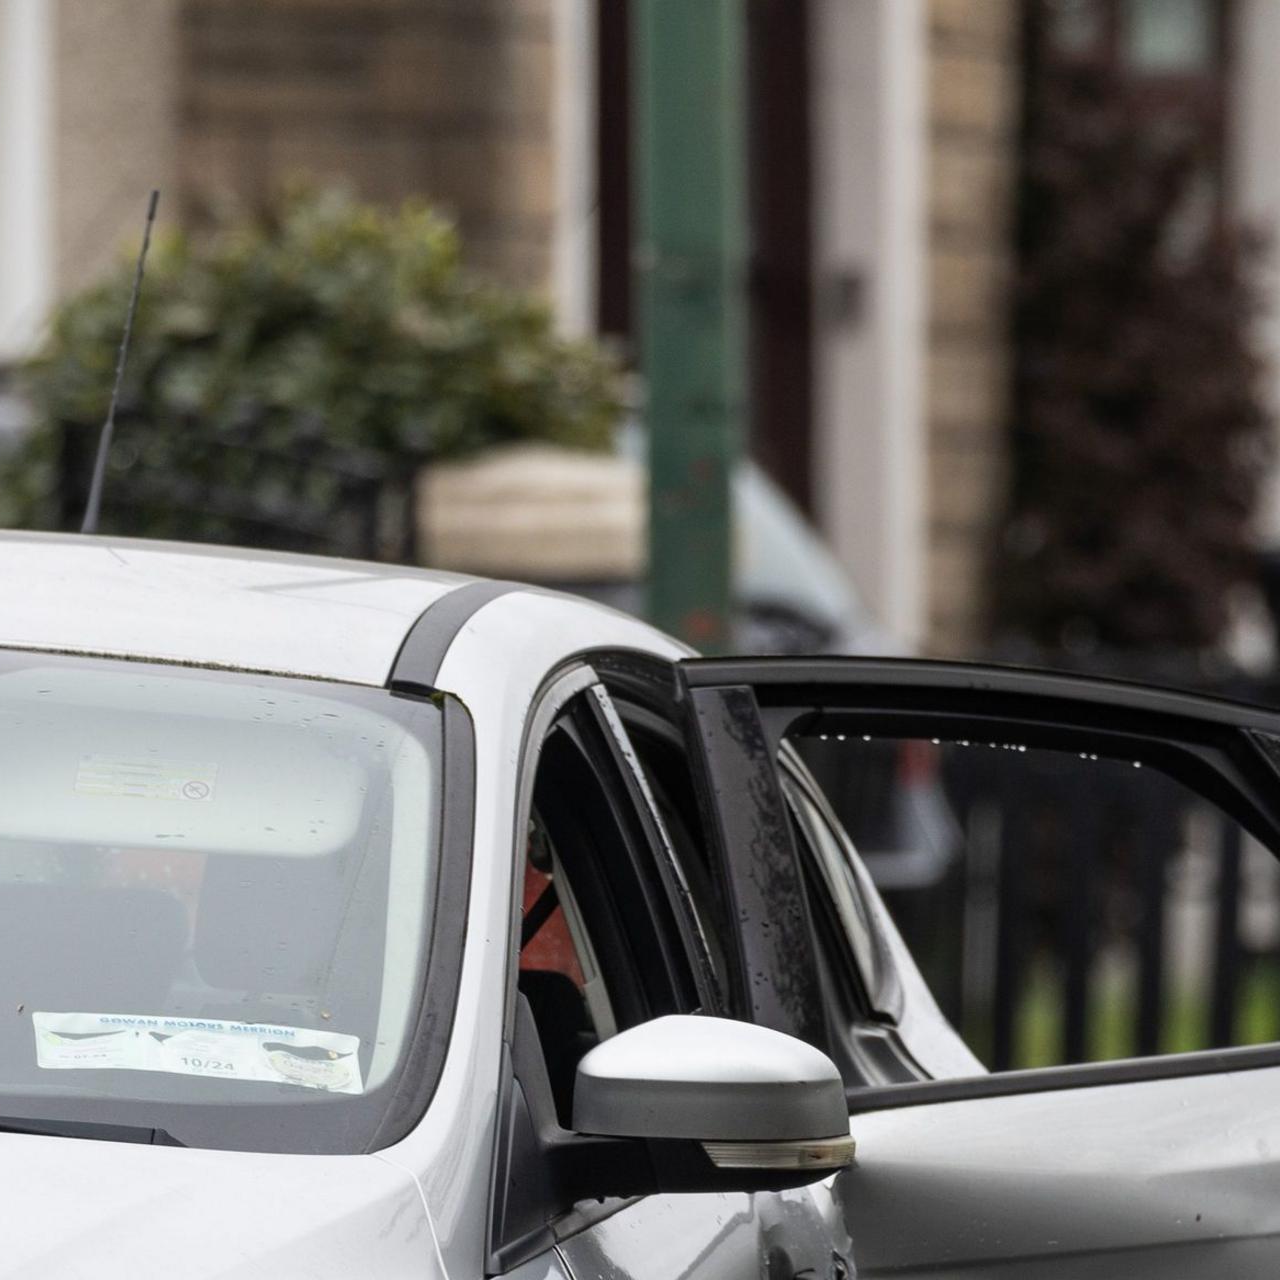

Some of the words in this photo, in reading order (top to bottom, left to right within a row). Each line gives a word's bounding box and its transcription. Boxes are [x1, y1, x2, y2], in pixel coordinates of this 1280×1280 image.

[99, 1016, 158, 1026] GOWAN
[163, 1020, 225, 1031] MOTORS
[230, 1024, 296, 1038] MERRION
[181, 1057, 235, 1071] 10/24
